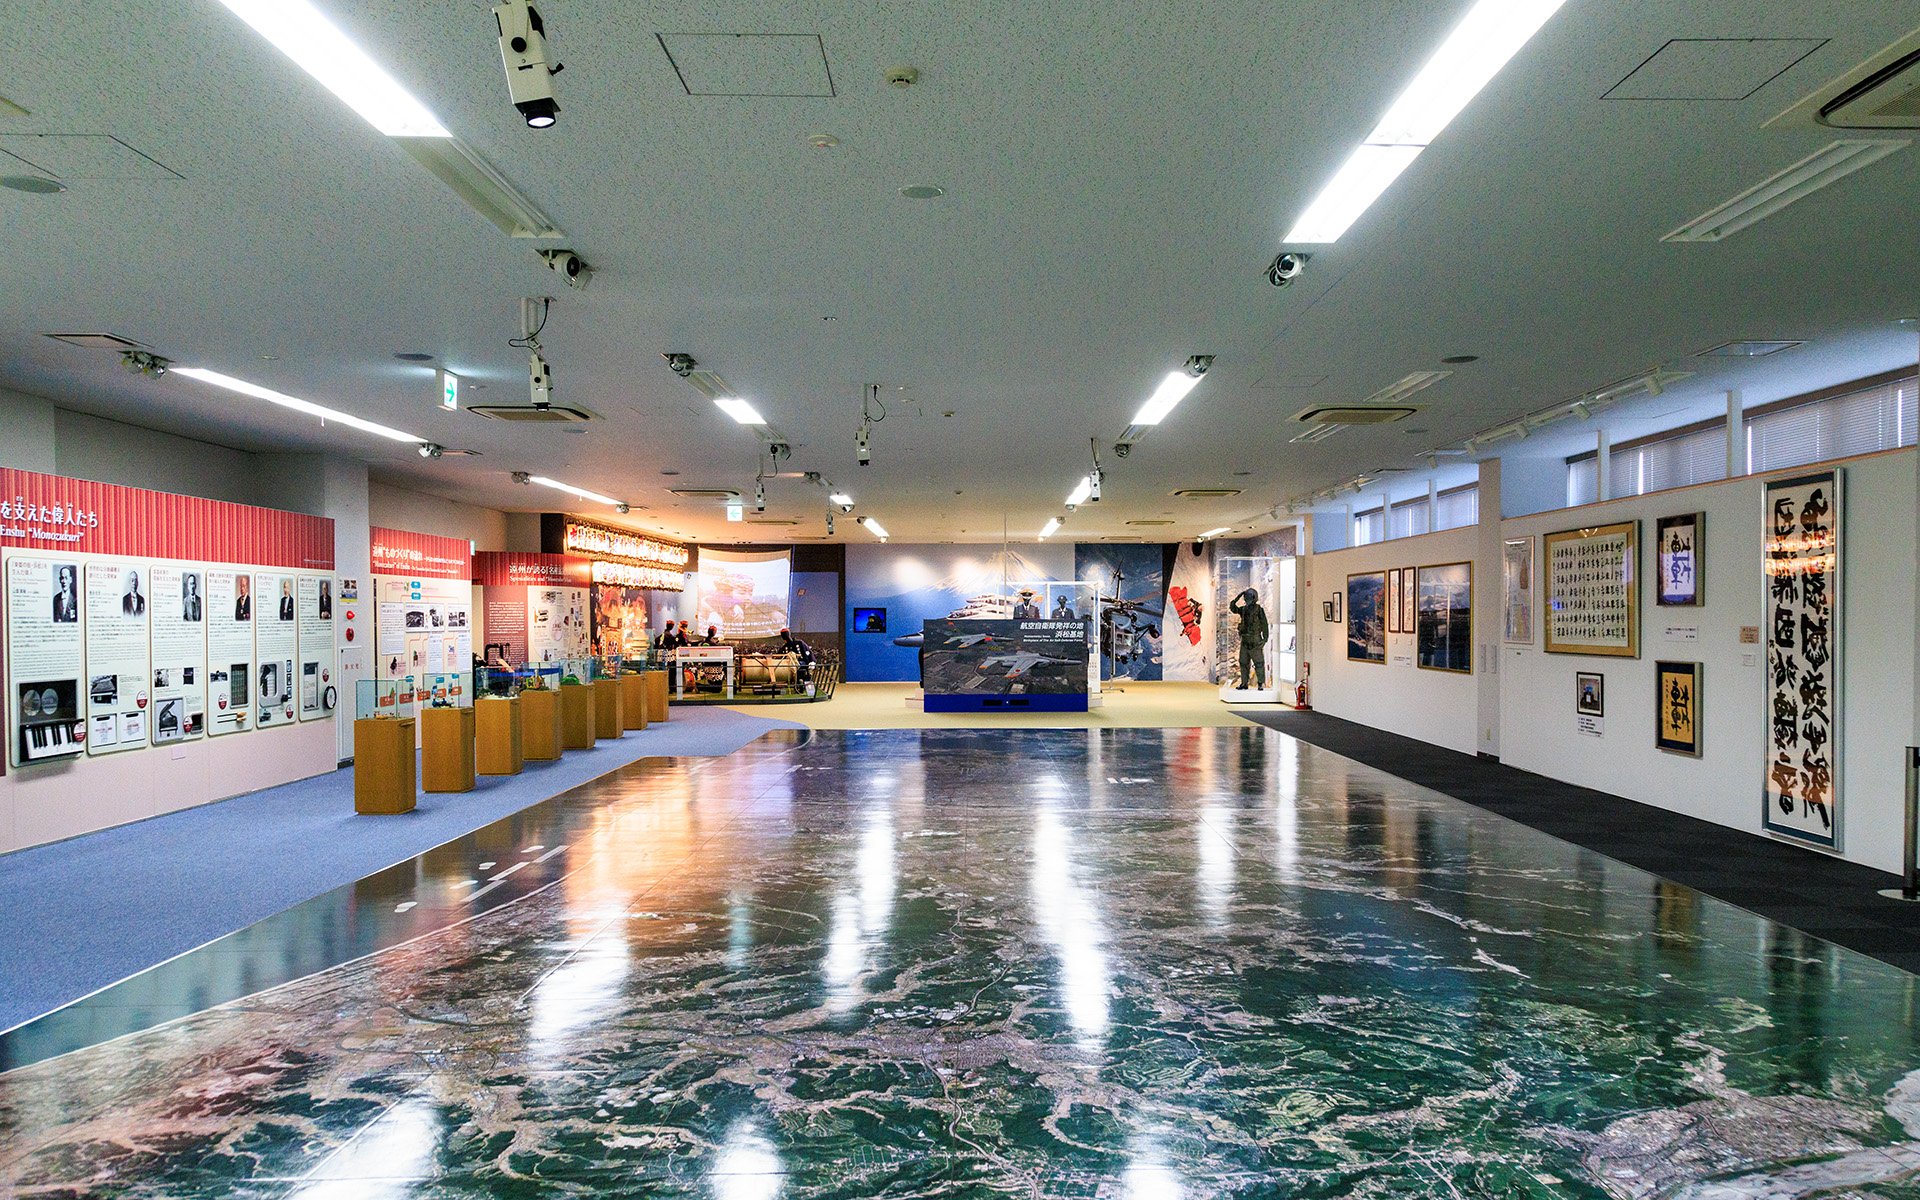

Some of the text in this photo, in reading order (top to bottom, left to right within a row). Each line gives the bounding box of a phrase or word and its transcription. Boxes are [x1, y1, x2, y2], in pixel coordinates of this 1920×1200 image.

[0, 501, 98, 528] を支えた偉人たち
[0, 525, 26, 537] Enshu
